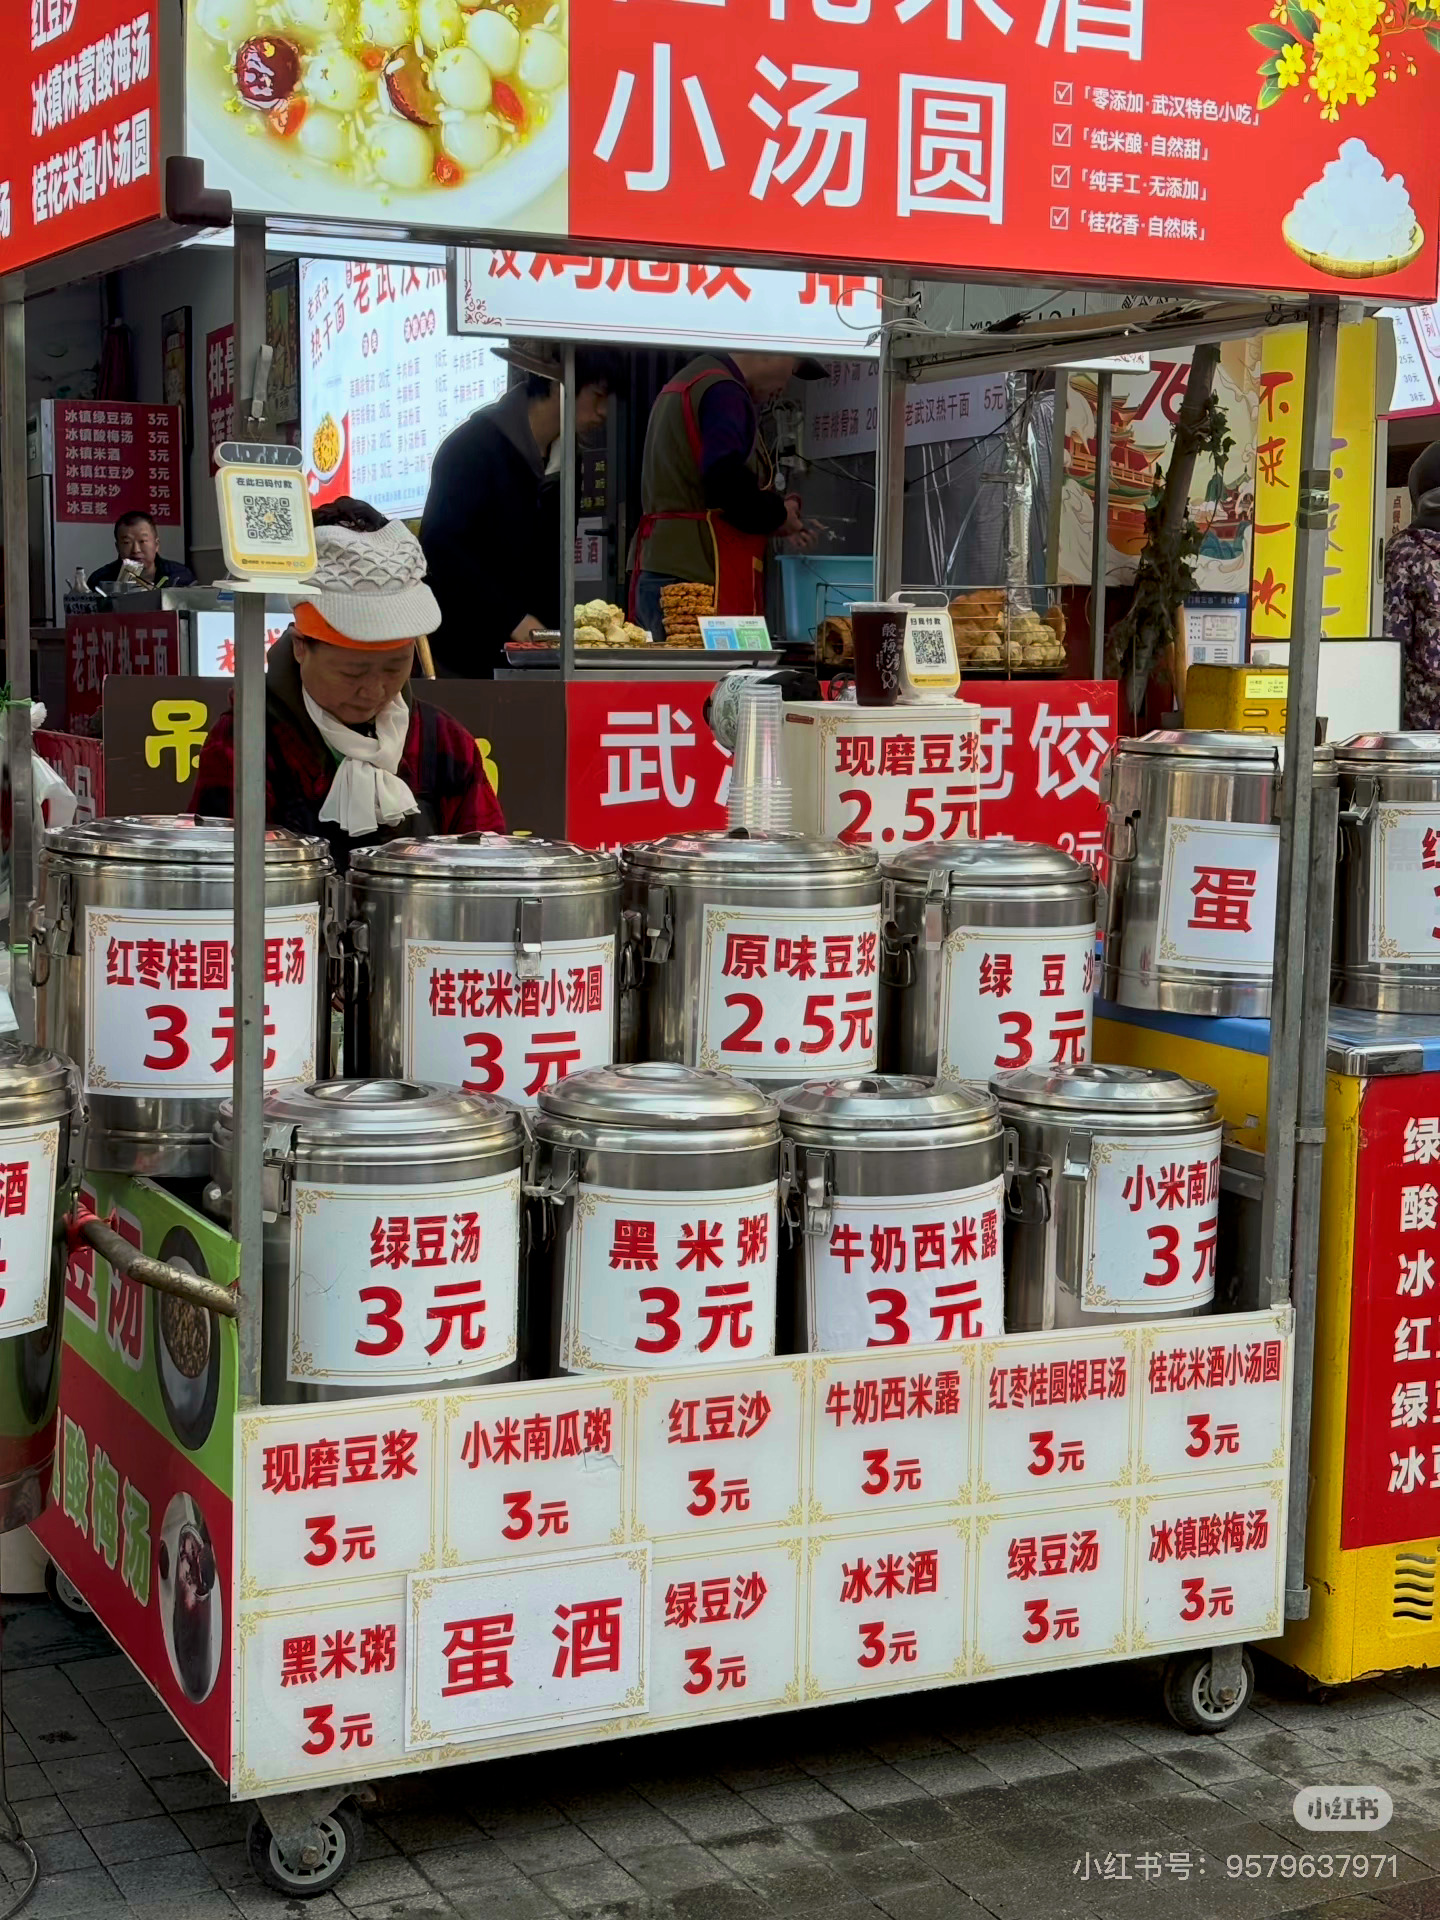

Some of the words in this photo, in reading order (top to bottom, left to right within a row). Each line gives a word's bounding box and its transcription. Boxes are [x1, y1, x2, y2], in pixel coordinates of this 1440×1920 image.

[593, 42, 1008, 225] 小汤圆
[32, 108, 150, 225] 桂花米酒小汤圆
[65, 409, 133, 425] 冰镇绿豆汤
[148, 413, 169, 426] 3元
[984, 385, 1004, 410] 5元
[65, 427, 134, 444] 冰镇酸梅汤
[148, 431, 169, 444] 3元
[65, 446, 120, 461] 冰镇米酒
[149, 449, 170, 462] 3元
[66, 464, 134, 480] 冰镇红豆沙
[149, 467, 170, 480] 3元
[66, 482, 121, 497] 绿豆冰沙
[149, 485, 170, 498] 3元
[67, 501, 108, 515] 冰豆浆
[150, 503, 171, 516] 3元
[835, 733, 980, 777] 现磨豆浆
[837, 786, 977, 843] 2.5元
[1187, 866, 1257, 933] 蛋
[106, 936, 305, 991] 红枣桂圆耳汤
[721, 931, 877, 981] 原味豆浆
[429, 964, 603, 1019] 桂花米酒小汤圆
[720, 990, 874, 1054] 2.5元
[993, 1009, 1087, 1069] 3元
[461, 1031, 583, 1097] 3元
[1400, 1183, 1439, 1242] 酸
[369, 1212, 482, 1270] 绿豆汤
[609, 1212, 769, 1272] 黑米粥
[829, 1208, 998, 1274] 牛奶西米露
[1396, 1249, 1436, 1298] 冰
[354, 1279, 488, 1357] 3元
[634, 1281, 754, 1354] 3元
[866, 1279, 984, 1347] 3元
[989, 1356, 1127, 1410] 红枣桂圆银耳汤
[1149, 1340, 1282, 1395] 桂花米酒小汤圆
[667, 1390, 771, 1444] 红豆沙
[825, 1370, 961, 1427] 牛奶西米露
[262, 1428, 419, 1495] 现磨豆浆
[461, 1406, 612, 1469] 小米南瓜粥
[1027, 1430, 1085, 1476] 3元
[1185, 1413, 1240, 1458] 3元
[686, 1468, 750, 1517] 3元
[861, 1448, 921, 1495] 3元
[303, 1515, 376, 1567] 3元
[501, 1490, 570, 1541] 3元
[1148, 1509, 1269, 1563] 冰镇酸梅汤
[840, 1549, 939, 1604] 冰米酒
[1007, 1530, 1099, 1581] 绿豆汤
[664, 1571, 768, 1629] 绿豆沙
[1022, 1598, 1080, 1644] 3元
[1179, 1577, 1234, 1622] 3元
[280, 1623, 396, 1688] 黑米粥
[441, 1597, 623, 1698] 蛋酒
[683, 1646, 746, 1695] 3元
[857, 1621, 918, 1668] 3元
[301, 1704, 373, 1756] 3元
